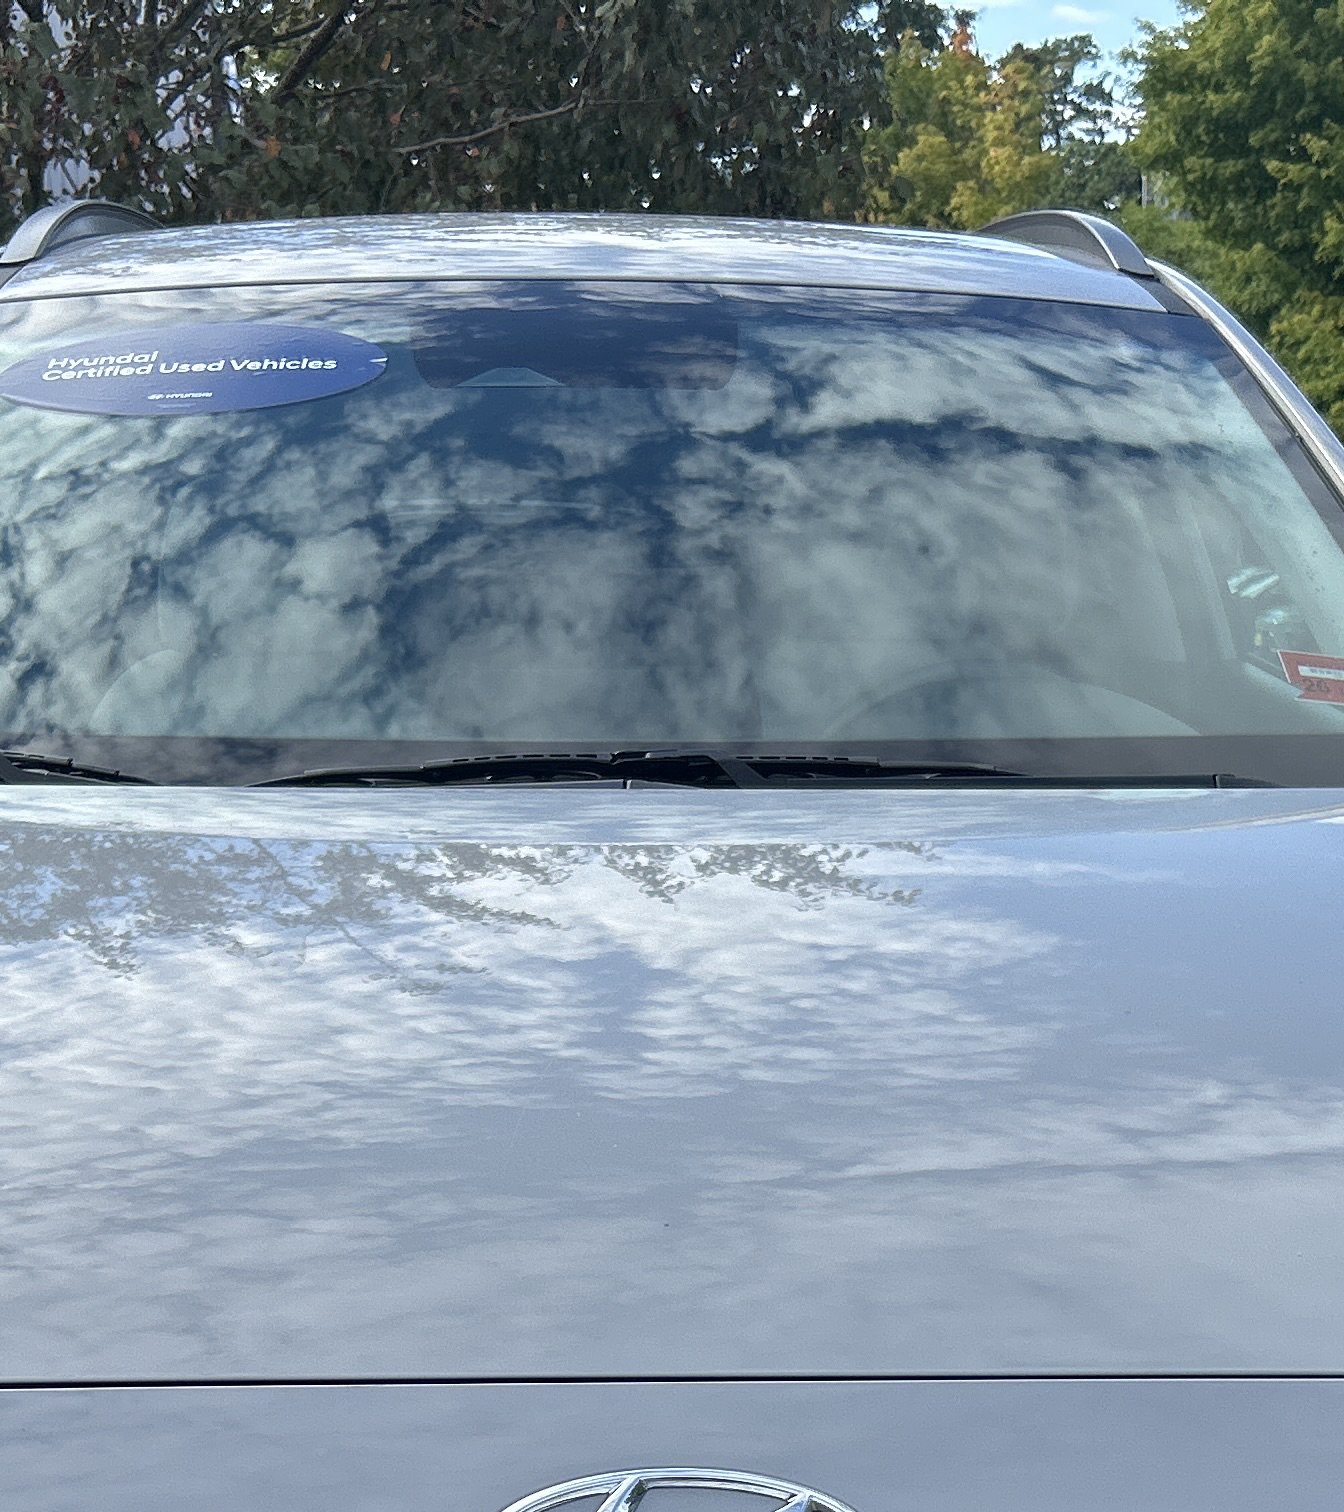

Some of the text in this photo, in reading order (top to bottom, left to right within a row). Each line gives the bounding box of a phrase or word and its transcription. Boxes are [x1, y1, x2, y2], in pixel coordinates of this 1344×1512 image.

[42, 357, 337, 381] Certified Used Vehicles
[48, 350, 159, 370] Hyundai
